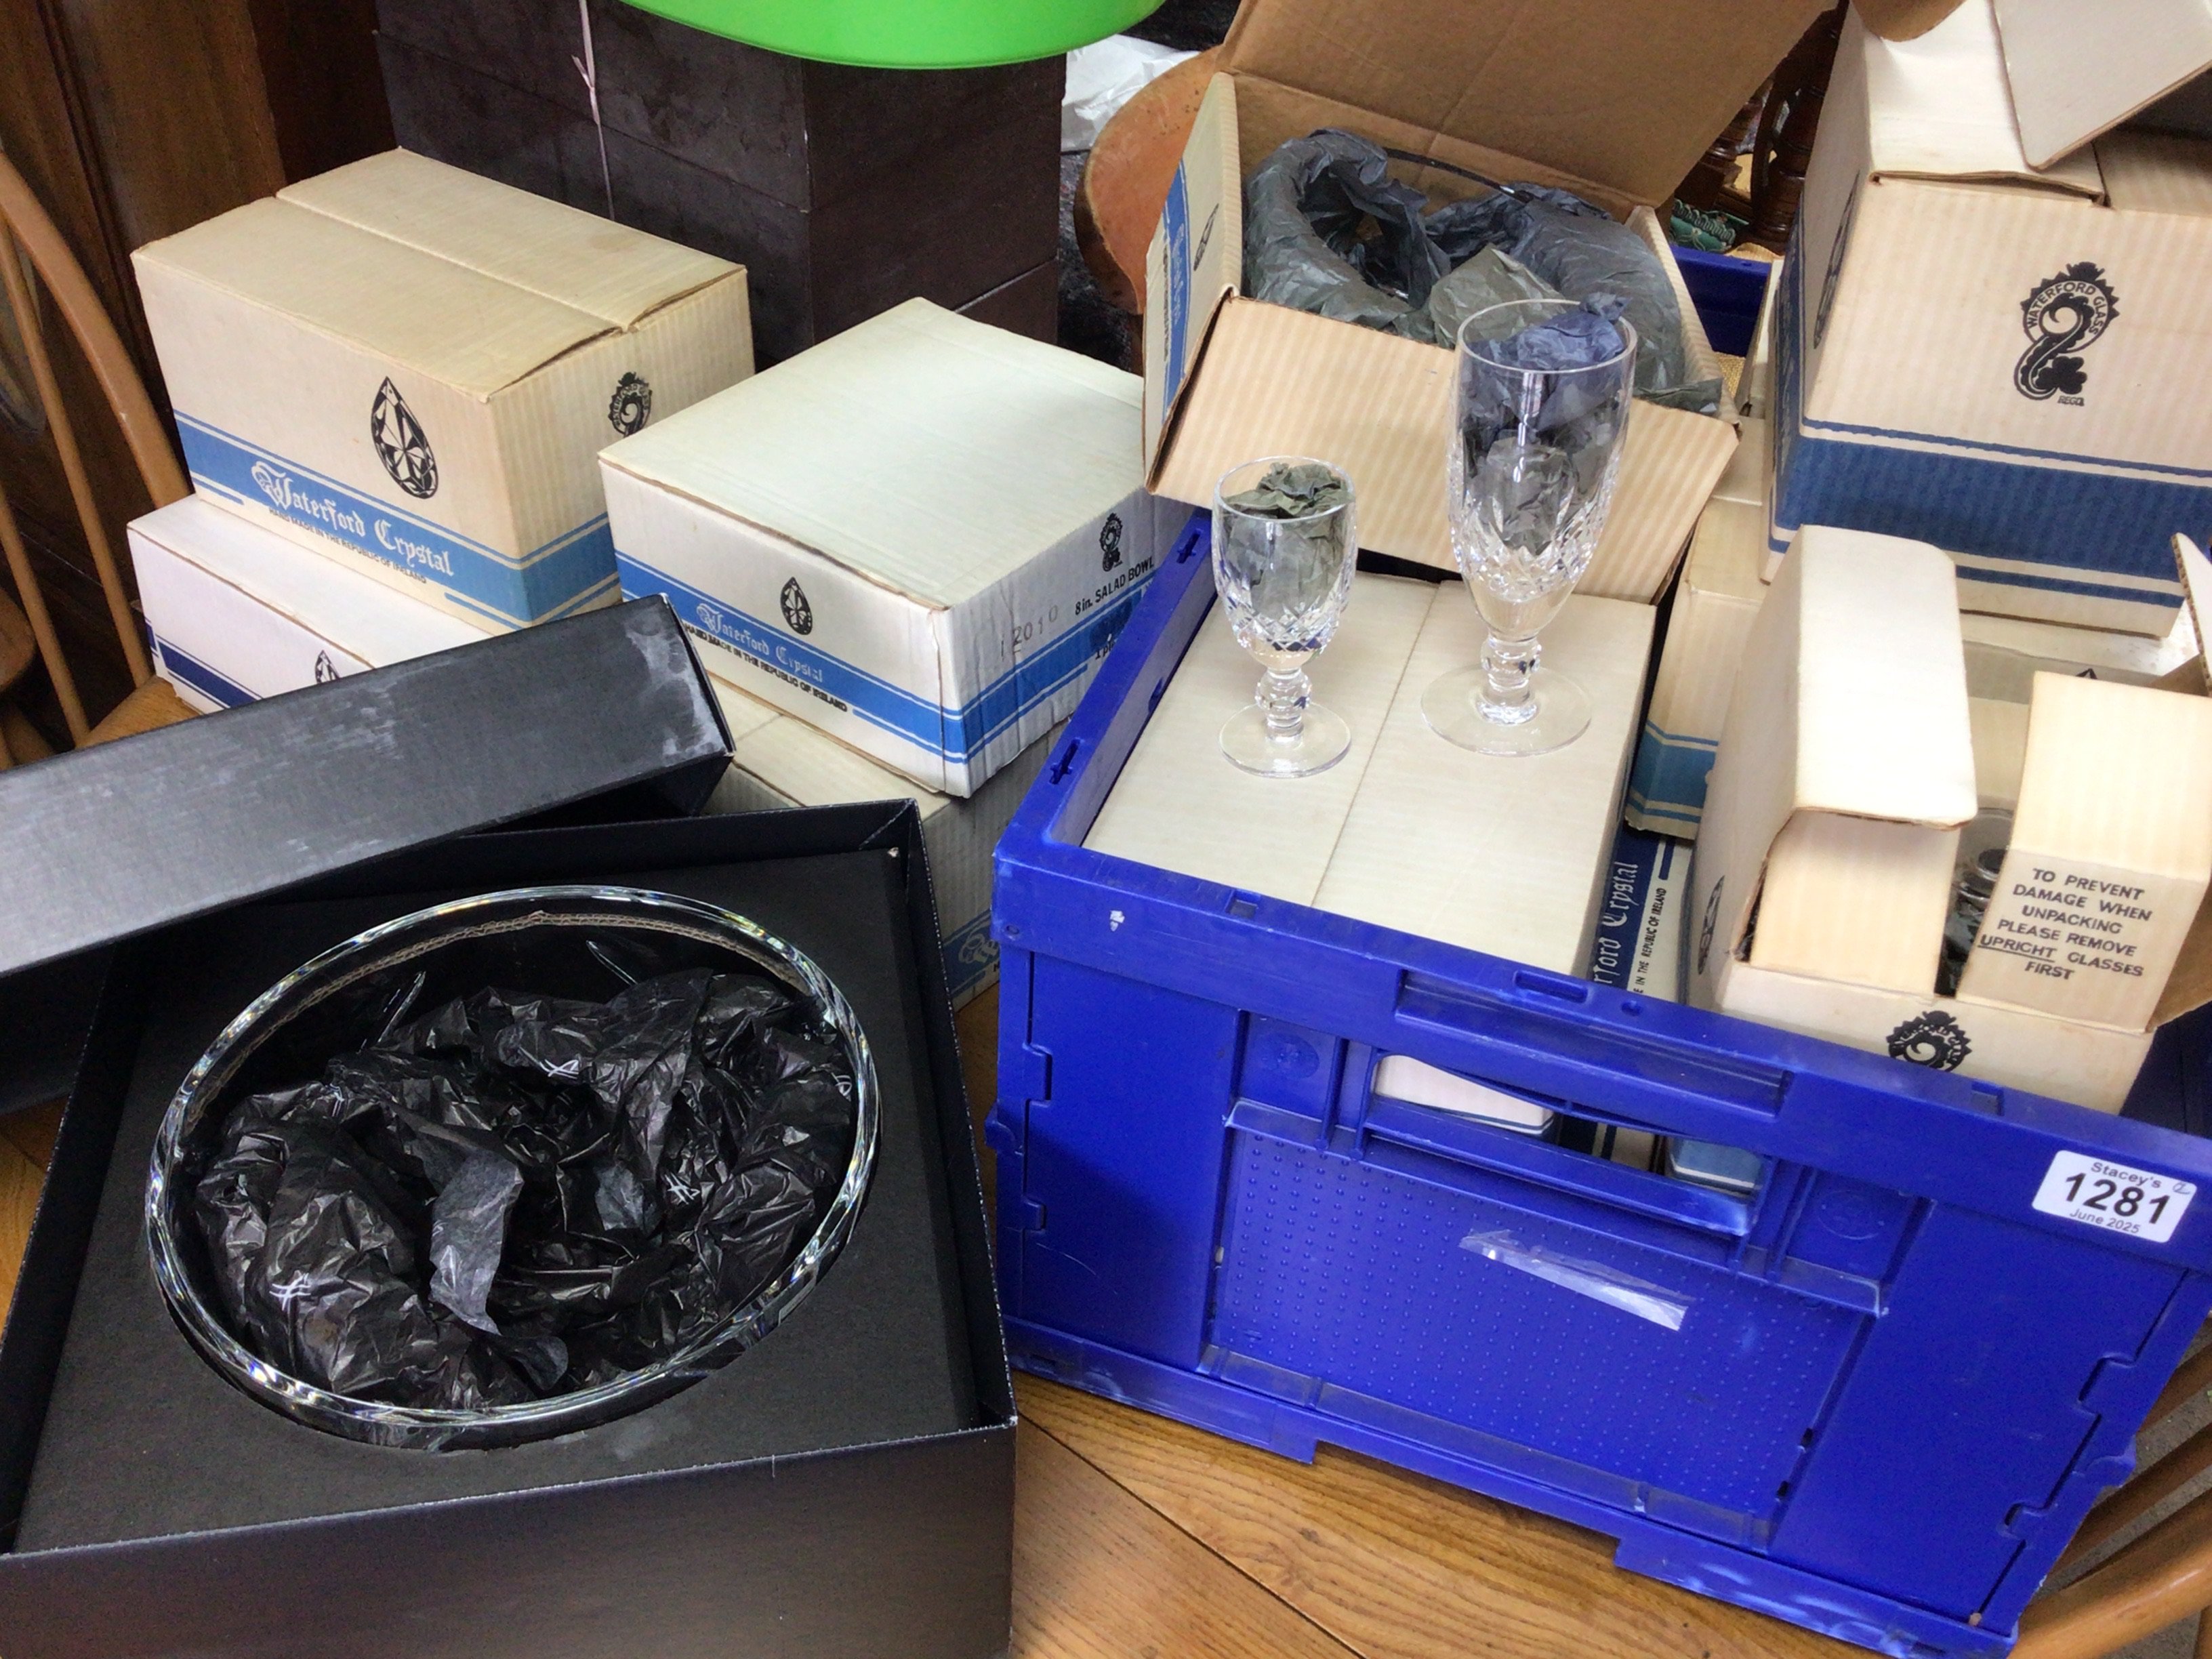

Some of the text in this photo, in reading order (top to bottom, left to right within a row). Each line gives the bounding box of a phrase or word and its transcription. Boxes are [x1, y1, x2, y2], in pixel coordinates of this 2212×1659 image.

[2026, 282, 2107, 335] WATERFORD GLASS
[251, 461, 454, 576] Waterford Crystal
[326, 531, 340, 545] THE
[340, 539, 380, 563] REPUBLIC
[380, 555, 392, 567] OF
[393, 562, 427, 584] IRELAND
[1094, 573, 1126, 602] SALAD
[1128, 556, 1154, 582] BOWL
[696, 602, 823, 684] Waterford Crystal
[733, 647, 743, 659] IN
[743, 651, 759, 668] THE
[760, 660, 799, 687] REPUBLIC
[800, 680, 812, 693] OF
[813, 687, 848, 713] IRELAND
[1651, 887, 1667, 916] IRELAND
[2013, 884, 2153, 922] DAMAGE WHEN
[2032, 867, 2145, 901] TO PREVENT
[1593, 861, 1639, 984] rford Crystal
[1647, 916, 1660, 926] OF
[1998, 919, 2137, 957] PLEASE REMOVE
[2022, 905, 2123, 935] UNPACKING
[1641, 927, 1658, 958] REPUBLIC
[1979, 935, 2145, 977] UPRIGHT GLASSES
[1635, 976, 1645, 986] IN
[1637, 960, 1650, 974] THE
[2024, 961, 2075, 981] FIRST
[2091, 1162, 2163, 1189] Stacey's
[2065, 1172, 2171, 1225] 1281
[2069, 1208, 2142, 1234] June 2025
